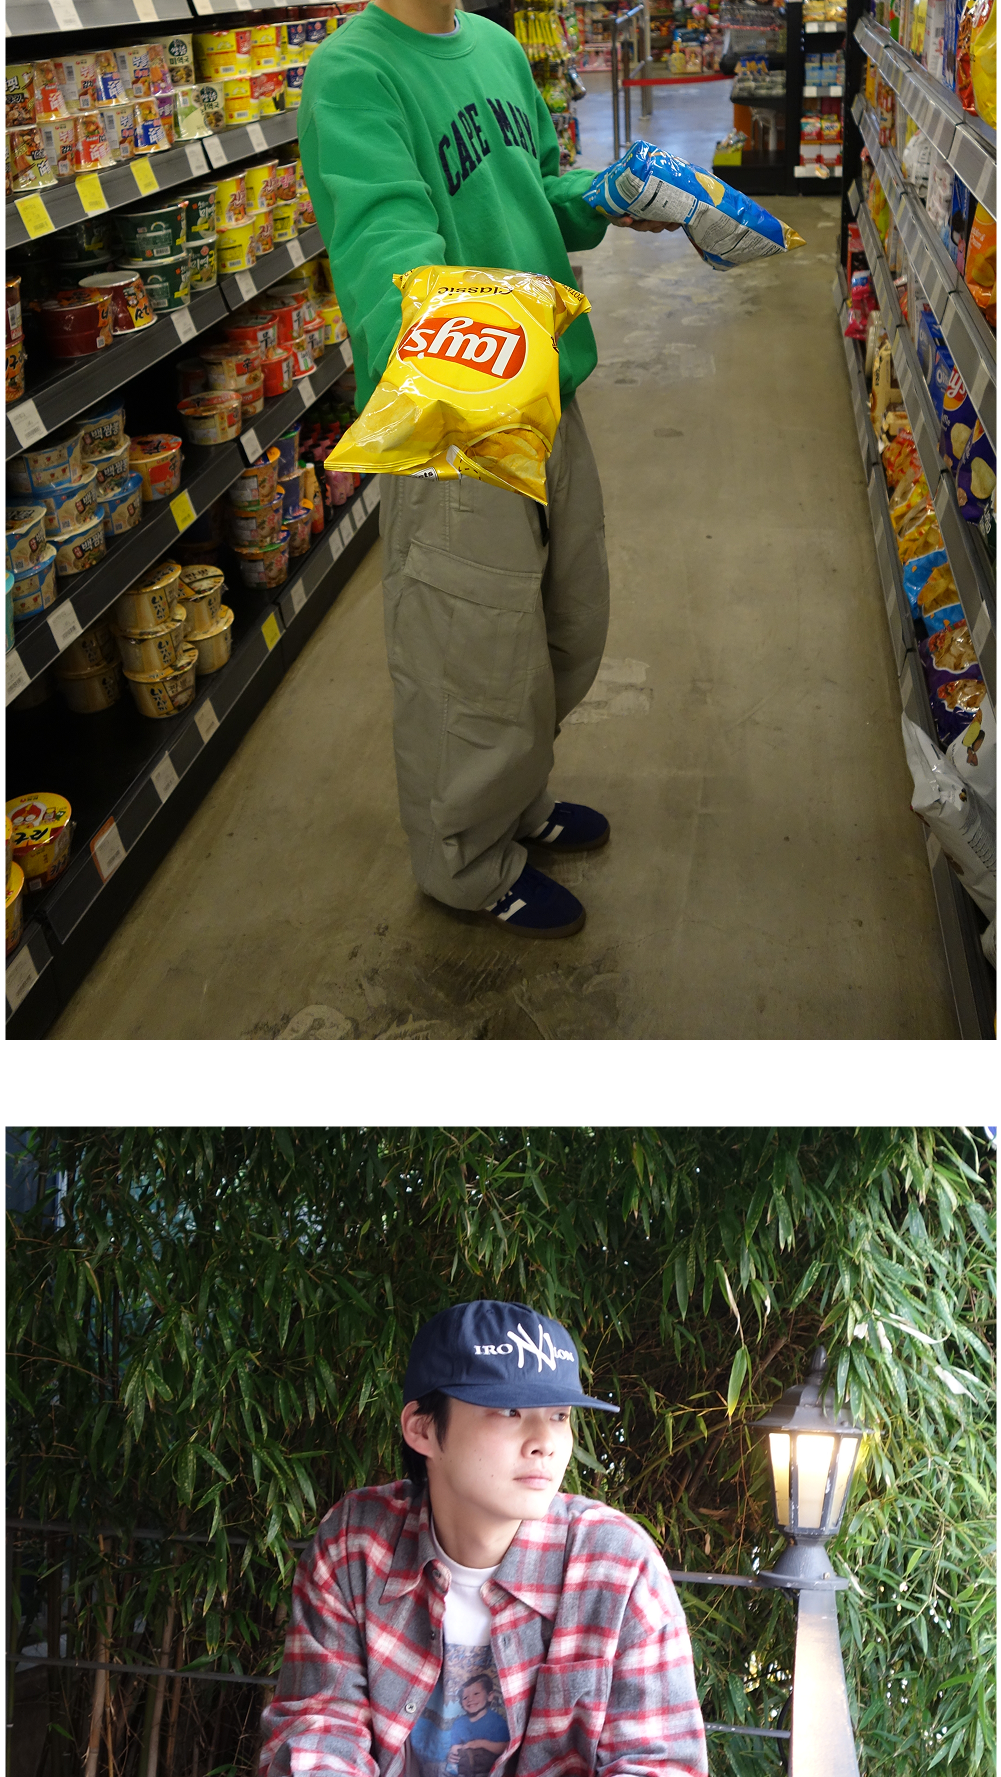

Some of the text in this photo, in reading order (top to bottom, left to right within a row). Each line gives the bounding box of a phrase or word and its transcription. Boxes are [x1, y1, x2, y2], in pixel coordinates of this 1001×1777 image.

[438, 102, 491, 197] CAPE
[437, 286, 514, 297] Classic
[402, 316, 521, 377] Lay's
